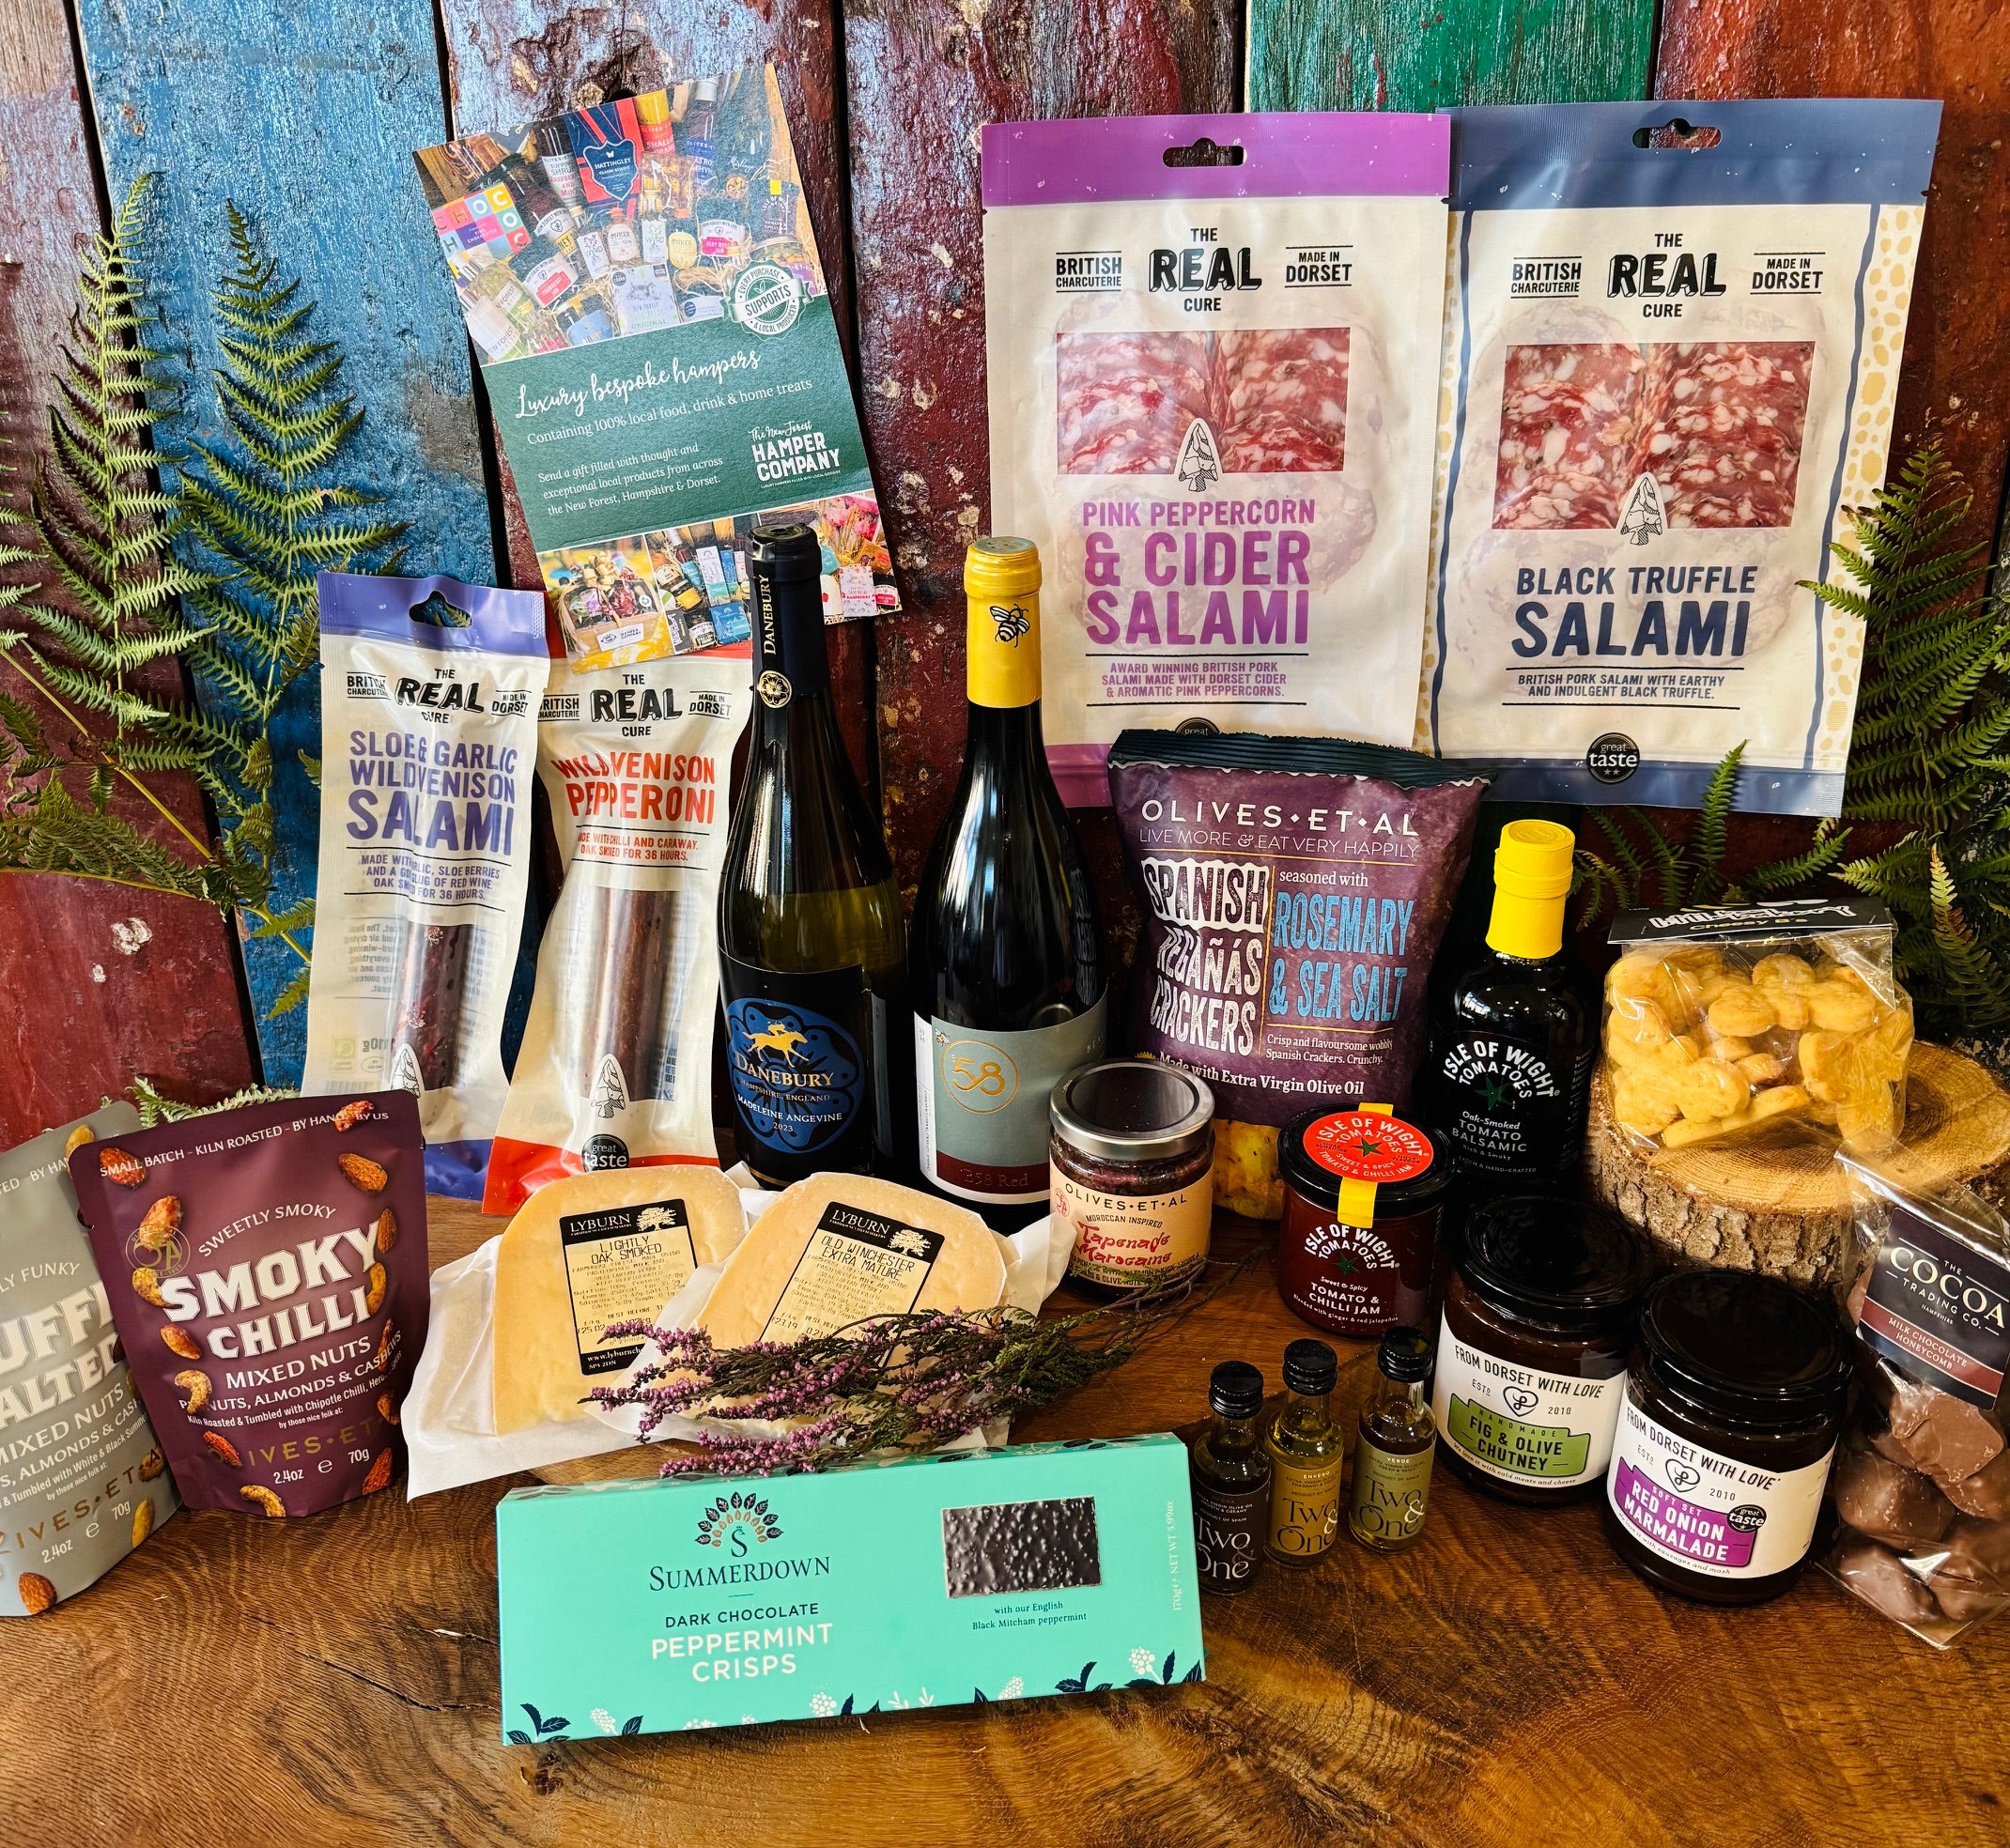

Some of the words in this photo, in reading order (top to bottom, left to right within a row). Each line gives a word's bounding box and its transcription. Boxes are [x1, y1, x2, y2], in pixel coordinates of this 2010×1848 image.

[595, 158, 631, 168] HATTINGLEY
[1191, 227, 1218, 241] THE
[1056, 256, 1121, 275] BRITISH
[1149, 247, 1262, 293] REAL
[1298, 252, 1326, 263] MADE
[1329, 251, 1339, 263] IN
[1056, 275, 1121, 287] CHARCUTERIE
[1285, 264, 1353, 283] DORSET
[745, 285, 791, 316] SUPPORTS
[1183, 298, 1221, 312] CURE
[516, 384, 588, 420] Luxury
[591, 361, 671, 403] bespoke
[672, 350, 761, 381] hampers
[528, 423, 594, 445] Containing
[595, 414, 626, 433] 100%
[628, 408, 657, 424] local
[660, 402, 692, 419] food,
[693, 395, 725, 412] drink
[728, 392, 736, 405] &
[738, 387, 774, 402] home
[776, 377, 812, 396] treats
[751, 432, 827, 462] HAMPER
[756, 448, 841, 482] COMPANY
[548, 502, 564, 516] the
[564, 499, 587, 513] New
[588, 494, 621, 511] Forest,
[622, 484, 675, 504] Hampshire
[676, 482, 686, 493] &
[687, 474, 721, 491] Dorset.
[1083, 501, 1140, 527] PINK
[1151, 499, 1316, 527] PEPPERCORN
[1084, 531, 1121, 587] &
[1144, 531, 1310, 587] CIDER
[1516, 567, 1616, 595] BLACK
[1628, 566, 1758, 594] TRUFFLE
[759, 574, 777, 655] DANEBURY
[1086, 590, 1309, 645] SALAMI
[1511, 600, 1751, 657] SALAMI
[1110, 662, 1149, 673] AWARD
[1152, 663, 1199, 673] WINNING
[1202, 662, 1245, 673] BRITISH
[1249, 662, 1277, 672] PORK
[1518, 674, 1563, 685] BRITISH
[1566, 673, 1596, 685] PORK
[1600, 674, 1643, 685] SALAMI
[1647, 675, 1676, 685] WITH
[1679, 675, 1725, 686] EARTHY
[590, 688, 683, 722] REAL
[1528, 686, 1551, 697] AND
[1554, 686, 1616, 698] INDULGENT
[1620, 686, 1657, 698] BLACK
[1662, 687, 1715, 700] TRUFFLE.
[349, 731, 415, 759] SLOE
[434, 740, 518, 775] GARLIC
[1589, 750, 1637, 768] taste
[1600, 742, 1627, 753] great
[349, 760, 415, 788] WILD
[419, 765, 516, 805] VENISON
[611, 752, 715, 784] VENISON
[565, 782, 715, 824] PEPPERONI
[346, 789, 515, 855] SALAMI
[1139, 828, 1173, 843] LIVE
[1178, 829, 1231, 846] MORE
[1238, 834, 1254, 847] &
[1258, 835, 1289, 850] EAT
[1292, 838, 1340, 854] VERY
[1344, 839, 1419, 858] HAPPILY
[1143, 863, 1266, 926] SPANISH
[1279, 870, 1337, 886] seasoned
[1338, 872, 1368, 887] with
[1273, 891, 1415, 957] ROSEMARY
[1269, 958, 1288, 1016] &
[1297, 961, 1341, 1020] SEA
[1350, 963, 1408, 1023] SALT
[1151, 975, 1257, 1056] CRACKERS
[734, 1052, 834, 1087] DANEBURY
[1191, 1063, 1219, 1082] with
[1221, 1070, 1257, 1088] Extra
[1260, 1074, 1305, 1094] Virgin
[1306, 1079, 1342, 1095] Olive
[1344, 1080, 1365, 1095] Oil
[1443, 1043, 1472, 1080] ISLE
[1473, 1040, 1499, 1057] OF
[1506, 1045, 1554, 1097] WIGHT
[1459, 1061, 1533, 1099] TOMATOES
[737, 1093, 783, 1120] MADELEINE
[786, 1113, 843, 1123] ANGEVINE
[1462, 1111, 1521, 1130] Oak-Smoked
[773, 1122, 793, 1132] 2023
[1452, 1127, 1527, 1152] BALSAMIC
[1459, 1119, 1522, 1141] TOMATO
[198, 1209, 270, 1257] SWEETLY
[274, 1203, 337, 1220] SMOKY
[570, 1213, 630, 1233] LYBURN
[832, 1209, 890, 1235] LYBURN
[1085, 1214, 1126, 1223] MOROCCAN
[1128, 1216, 1164, 1228] INSPIRED
[591, 1252, 612, 1265] OAK
[620, 1243, 662, 1260] SMOKED
[599, 1236, 650, 1253] LIGHTLY
[821, 1235, 843, 1250] OLD
[847, 1243, 915, 1272] WINCHESTER
[1305, 1225, 1328, 1255] ISLE
[1329, 1224, 1351, 1238] OF
[1354, 1227, 1395, 1269] WIGHT
[1319, 1240, 1378, 1270] TOMATOES
[20, 1260, 81, 1283] FUNKY
[158, 1221, 380, 1323] SMOKY
[822, 1247, 857, 1267] EXTRA
[861, 1260, 903, 1281] MATURE
[1943, 1260, 1962, 1276] THE
[1308, 1292, 1351, 1313] CHILLI
[1353, 1304, 1381, 1315] JAM
[1311, 1283, 1366, 1303] TOMATO
[1370, 1296, 1380, 1304] &
[1890, 1246, 2005, 1329] COCOA
[1902, 1277, 1958, 1315] TRADING
[1962, 1313, 1982, 1330] CO.
[208, 1286, 372, 1360] CHILLI
[1888, 1317, 1910, 1335] MILK
[1912, 1331, 1968, 1367] CHOCOLATE
[1895, 1332, 1953, 1370] HONEYCOMB
[224, 1360, 307, 1390] MIXED
[310, 1336, 372, 1372] NUTS
[1455, 1345, 1480, 1368] FROM
[1484, 1359, 1533, 1387] DORSET
[1538, 1377, 1569, 1394] WITH
[1573, 1383, 1604, 1398] LOVE
[74, 1382, 124, 1432] NUTS
[1548, 1407, 1571, 1415] 2010
[1469, 1415, 1492, 1438] FIG
[1499, 1433, 1508, 1445] &
[1515, 1438, 1563, 1455] OLIVE
[1478, 1409, 1556, 1438] HANDMADE
[348, 1447, 370, 1465] 70g
[1477, 1439, 1549, 1471] CHUTNEY
[273, 1467, 304, 1485] 2.4oz
[1366, 1475, 1421, 1507] Two
[1631, 1480, 1659, 1514] RED
[1665, 1503, 1724, 1542] ONION
[1729, 1512, 1765, 1527] taste
[1624, 1493, 1729, 1562] MARMALADE
[649, 1555, 831, 1592] SUMMERDOWN
[665, 1612, 711, 1629] DARK
[718, 1603, 819, 1624] CHOCOLATE
[972, 1619, 996, 1630] Black
[998, 1617, 1036, 1628] Mitcham
[1038, 1612, 1088, 1625] peppermint
[994, 1606, 1013, 1614] with
[1015, 1605, 1029, 1613] our
[1032, 1601, 1063, 1613] English
[651, 1623, 833, 1660] PEPPERMINT
[692, 1654, 796, 1683] CRISPS
